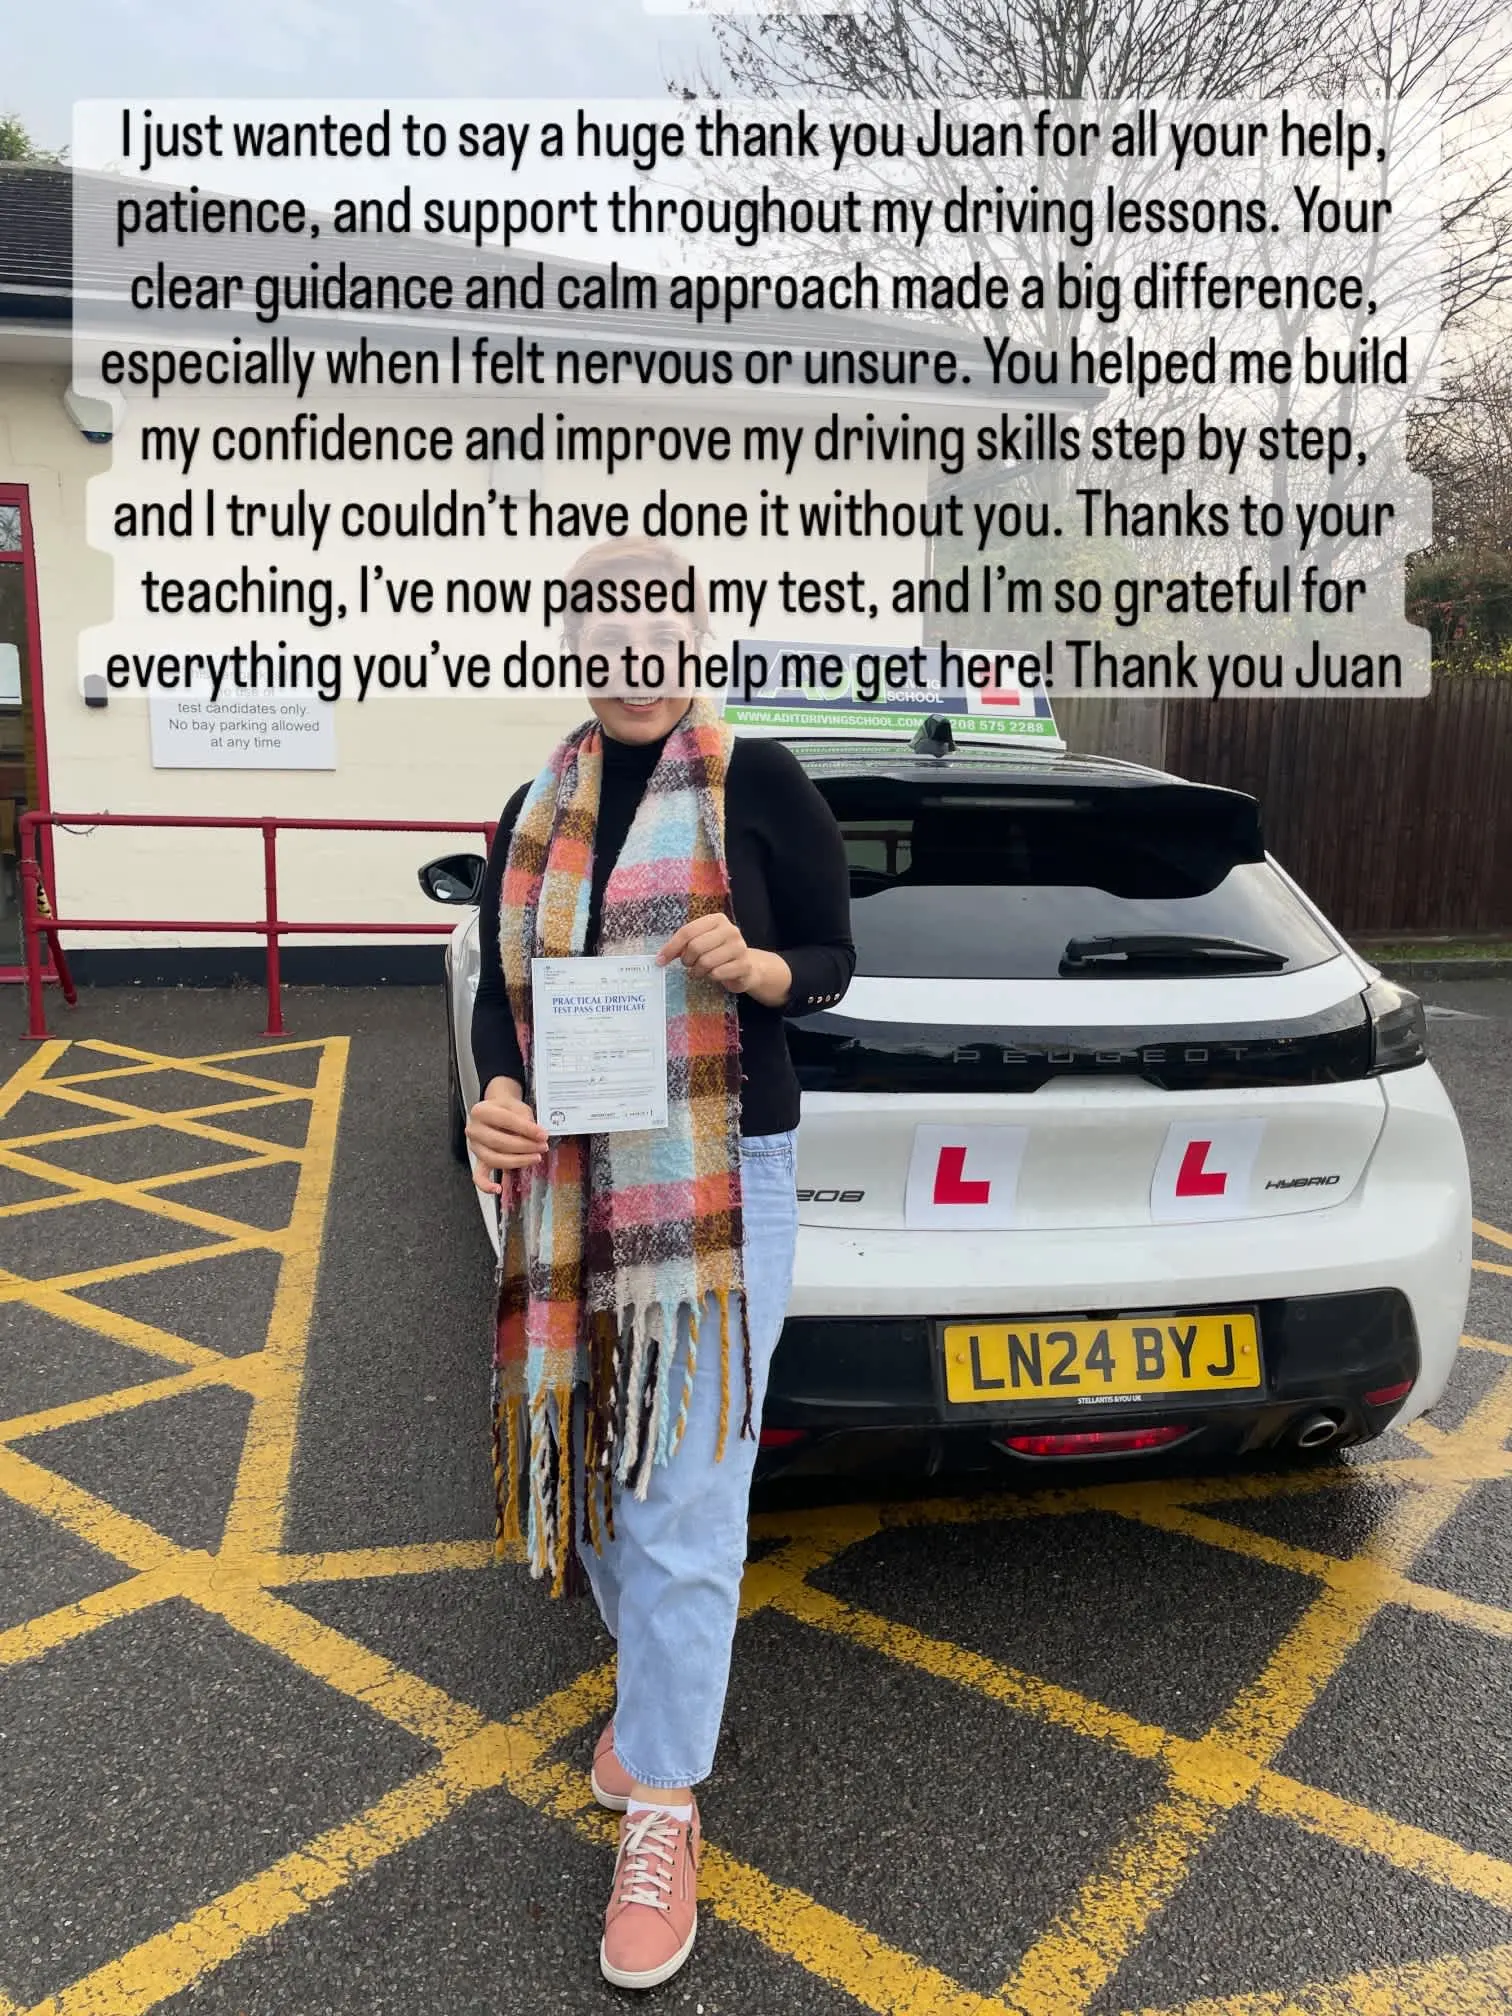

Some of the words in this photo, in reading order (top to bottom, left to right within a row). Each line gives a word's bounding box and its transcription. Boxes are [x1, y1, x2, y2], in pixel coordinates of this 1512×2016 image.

[887, 690, 945, 704] SCHOOL
[178, 703, 201, 713] test
[206, 703, 277, 714] candidates
[280, 703, 310, 717] only.
[169, 719, 188, 730] No
[192, 719, 216, 733] bay
[220, 719, 268, 734] parking
[271, 719, 320, 732] allowed
[951, 719, 976, 731] 208
[979, 720, 1005, 732] 575
[1010, 722, 1045, 734] 2288
[210, 737, 223, 748] at
[226, 738, 250, 750] any
[254, 737, 281, 748] time
[552, 996, 602, 1006] PRACTICAL
[605, 994, 646, 1004] DRIVING
[553, 1006, 572, 1014] TEST
[574, 1005, 594, 1013] PASS
[595, 1003, 646, 1013] CERTIFICATE
[952, 1047, 1249, 1064] PEUGEOT
[933, 1146, 991, 1205] L
[1176, 1141, 1227, 1196] L
[1264, 1175, 1341, 1190] HYBRID
[796, 1190, 866, 1203] 208
[968, 1328, 1117, 1391] LN24
[1131, 1323, 1236, 1381] BYJ
